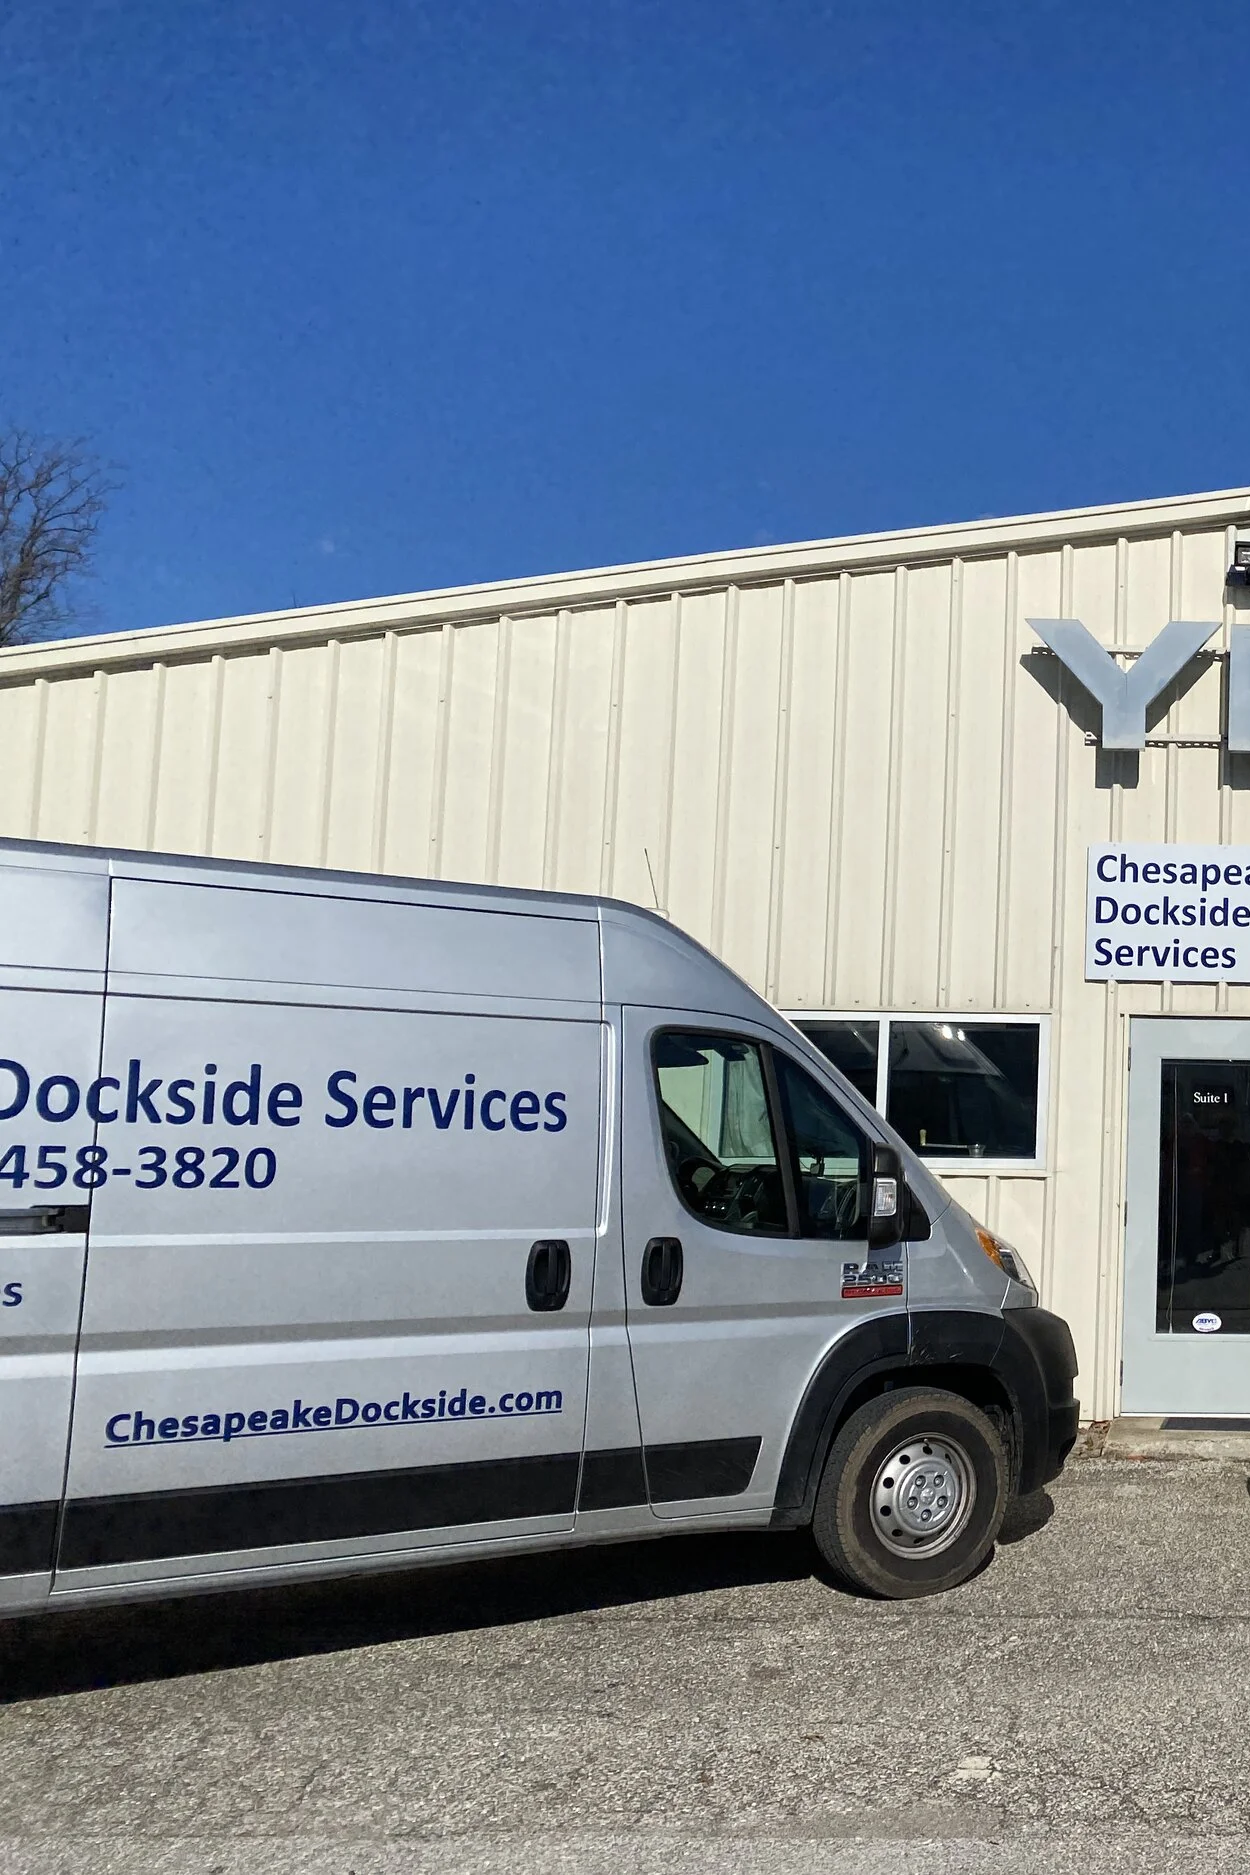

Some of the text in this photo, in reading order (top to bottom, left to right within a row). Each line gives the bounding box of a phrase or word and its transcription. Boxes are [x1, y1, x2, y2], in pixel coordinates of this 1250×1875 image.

[1095, 896, 1250, 928] Dockside
[1094, 938, 1236, 969] Services
[0, 1059, 567, 1133] Dockside Services
[1193, 1091, 1220, 1103] Suite
[0, 1145, 277, 1189] 458-3820
[103, 1388, 563, 1448] ChesapeakeDockside.com
